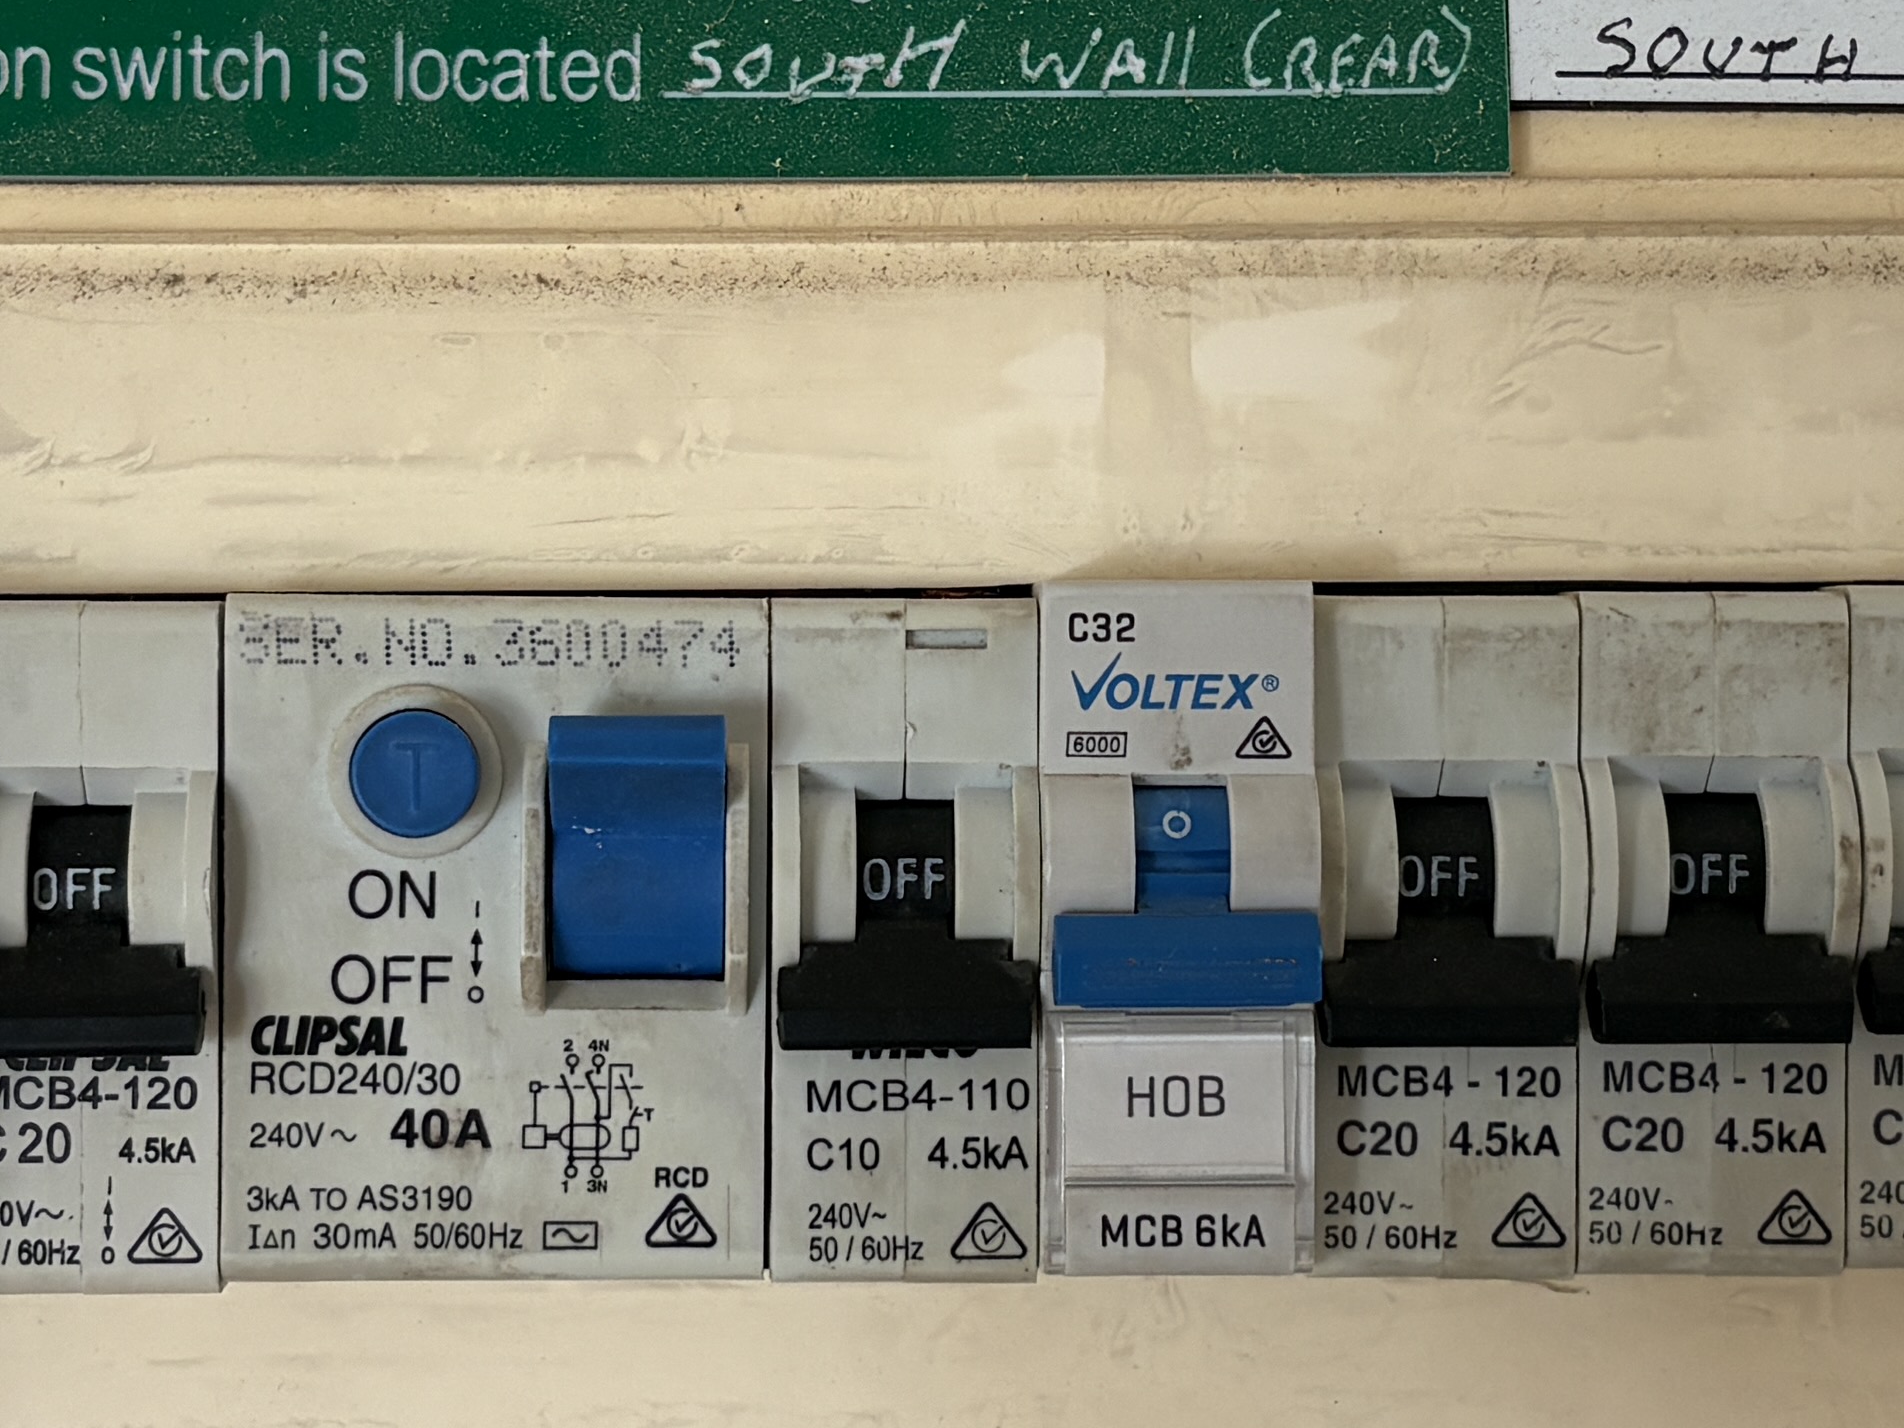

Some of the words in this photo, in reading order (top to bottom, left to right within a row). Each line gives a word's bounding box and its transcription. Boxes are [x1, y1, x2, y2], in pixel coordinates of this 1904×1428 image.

[688, 18, 967, 103] SOUTH
[1245, 6, 1472, 99] (REAR)
[1594, 16, 1859, 81] SOUTH
[71, 31, 300, 102] switch
[319, 31, 369, 102] is
[391, 32, 644, 105] located
[1067, 613, 1136, 643] C32
[1073, 736, 1120, 753] 6000
[33, 868, 116, 910] OFF
[862, 858, 945, 901] OFF
[1399, 855, 1479, 897] OFF
[1669, 853, 1750, 896] OFF
[348, 869, 437, 920] ON
[331, 954, 453, 1005] OFF
[250, 1015, 408, 1057] CLIPSAL
[588, 1039, 610, 1052] 4N
[250, 1061, 461, 1095] RCD240/30
[805, 1078, 1030, 1113] MCB4-110
[1127, 1075, 1226, 1118] HOB
[389, 1108, 491, 1149] 40A
[1336, 1121, 1418, 1157] C20
[1449, 1122, 1560, 1157] 4.5kA
[1602, 1117, 1684, 1153] C20
[1714, 1118, 1827, 1154] 4.5kA
[118, 1136, 196, 1164] 4.5kA
[806, 1138, 880, 1171] C10
[928, 1136, 1028, 1170] 4.5kA
[587, 1179, 608, 1193] 3N
[654, 1167, 709, 1188] RCD
[246, 1185, 299, 1212] 3kA
[310, 1187, 348, 1211] TO
[357, 1185, 473, 1212] AS3190
[313, 1223, 396, 1250] 30mA
[413, 1222, 523, 1250] 50/60Hz
[1101, 1215, 1184, 1248] MCB
[1196, 1213, 1266, 1247] 6kA
